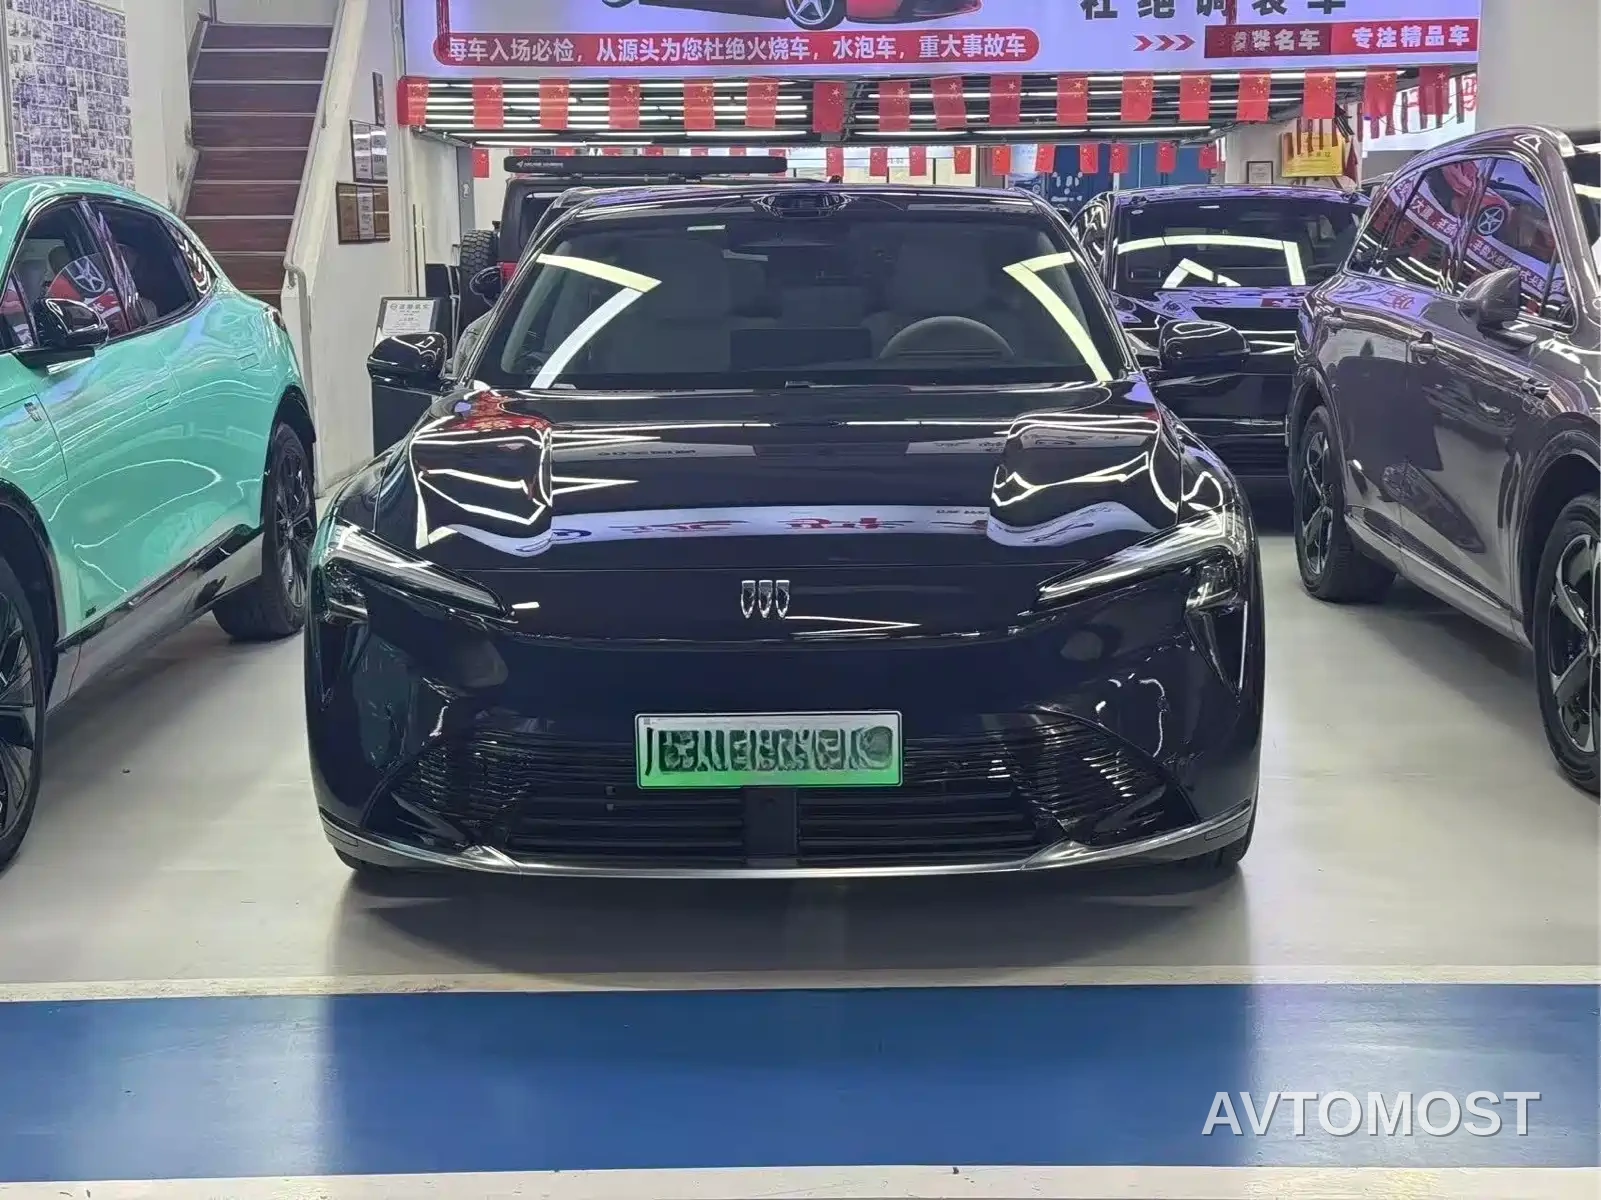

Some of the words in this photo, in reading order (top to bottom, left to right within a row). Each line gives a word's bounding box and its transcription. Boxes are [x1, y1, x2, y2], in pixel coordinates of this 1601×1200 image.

[1351, 24, 1470, 50] 专注精品车
